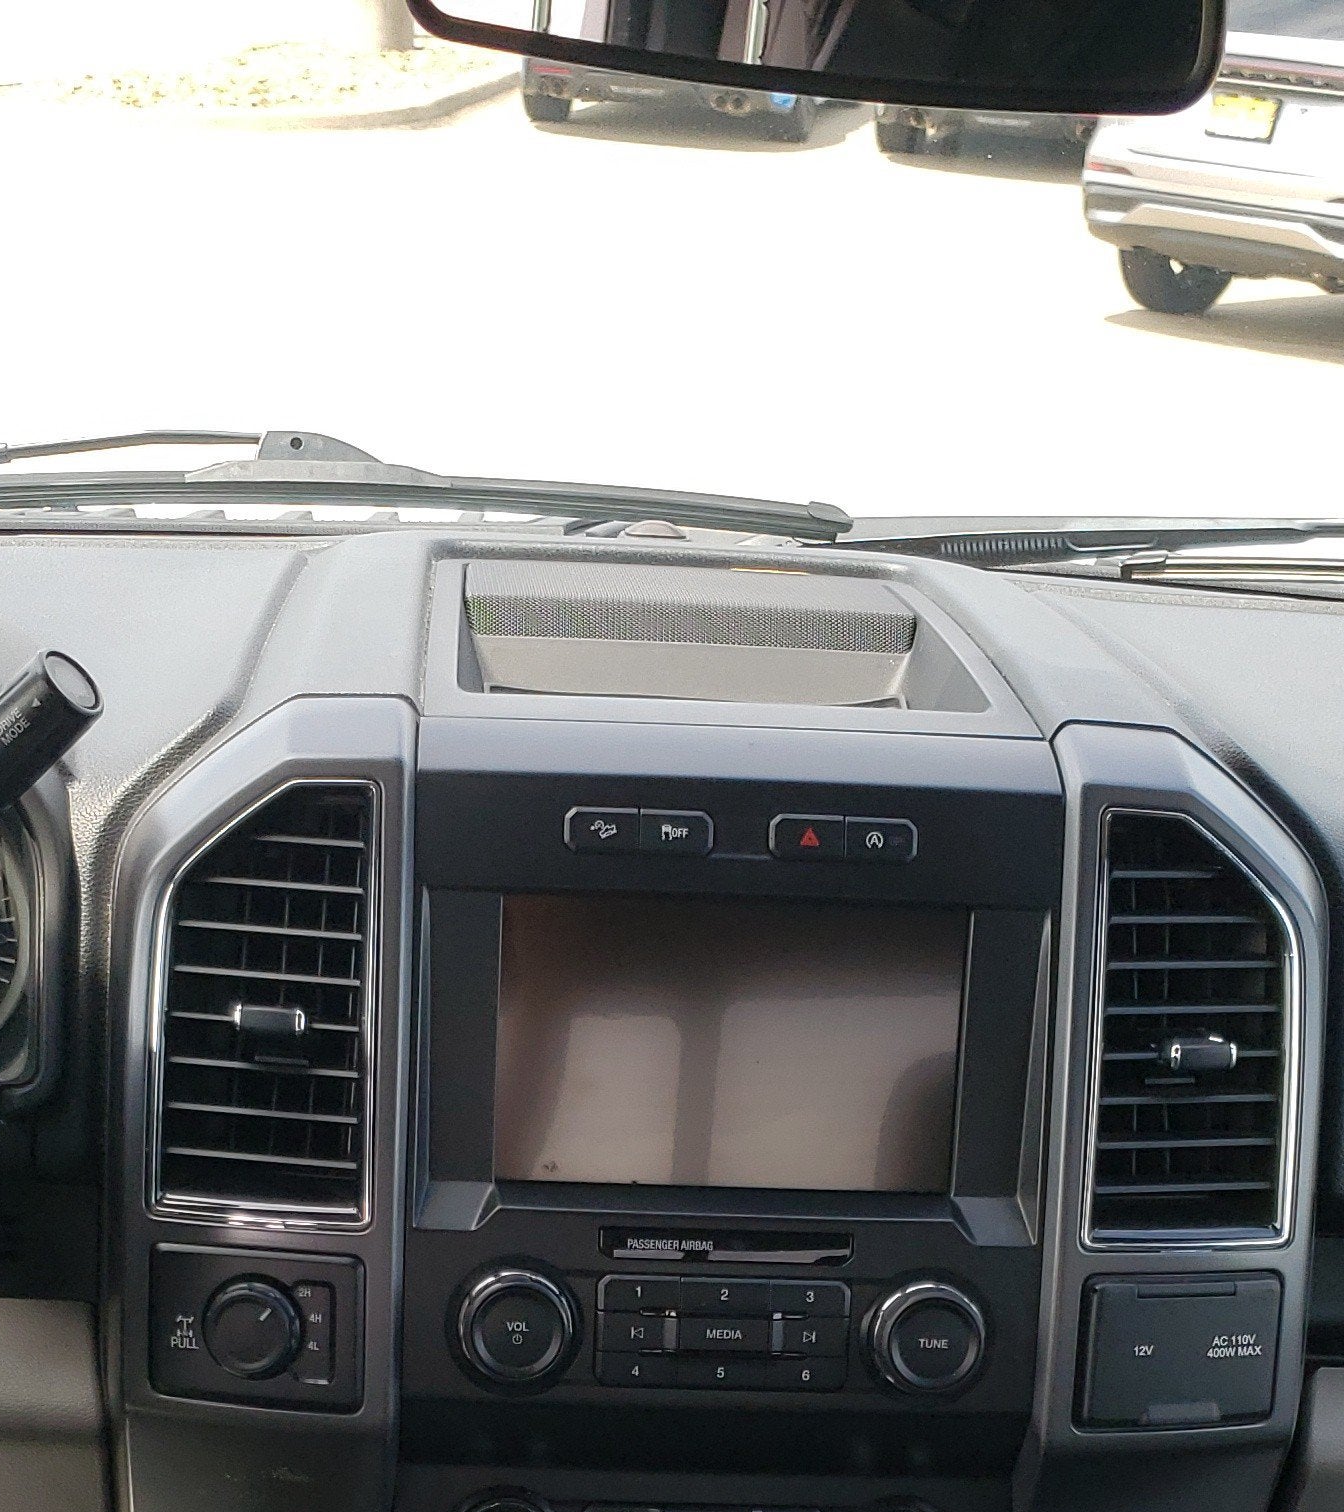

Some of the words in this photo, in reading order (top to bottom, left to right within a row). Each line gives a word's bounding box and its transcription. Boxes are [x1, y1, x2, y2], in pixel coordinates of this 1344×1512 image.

[1, 717, 31, 745] MODE
[671, 827, 690, 840] OFF
[627, 1238, 680, 1251] PASSENGER
[680, 1240, 714, 1252] AIRBAG
[720, 1289, 729, 1301] 2
[806, 1291, 815, 1303] 3
[308, 1314, 322, 1324] 4H
[506, 1321, 530, 1332] VOL
[706, 1328, 742, 1340] MEDIA
[1212, 1335, 1229, 1346] AC
[1230, 1333, 1257, 1345] 110V
[170, 1336, 200, 1350] PULL
[308, 1341, 320, 1351] 4L
[918, 1338, 949, 1349] TUNE
[1133, 1344, 1154, 1357] 12V
[1207, 1346, 1237, 1359] 400W
[1238, 1345, 1262, 1357] MAX
[631, 1365, 640, 1377] 4
[716, 1367, 725, 1379] 5
[801, 1369, 811, 1381] 6
